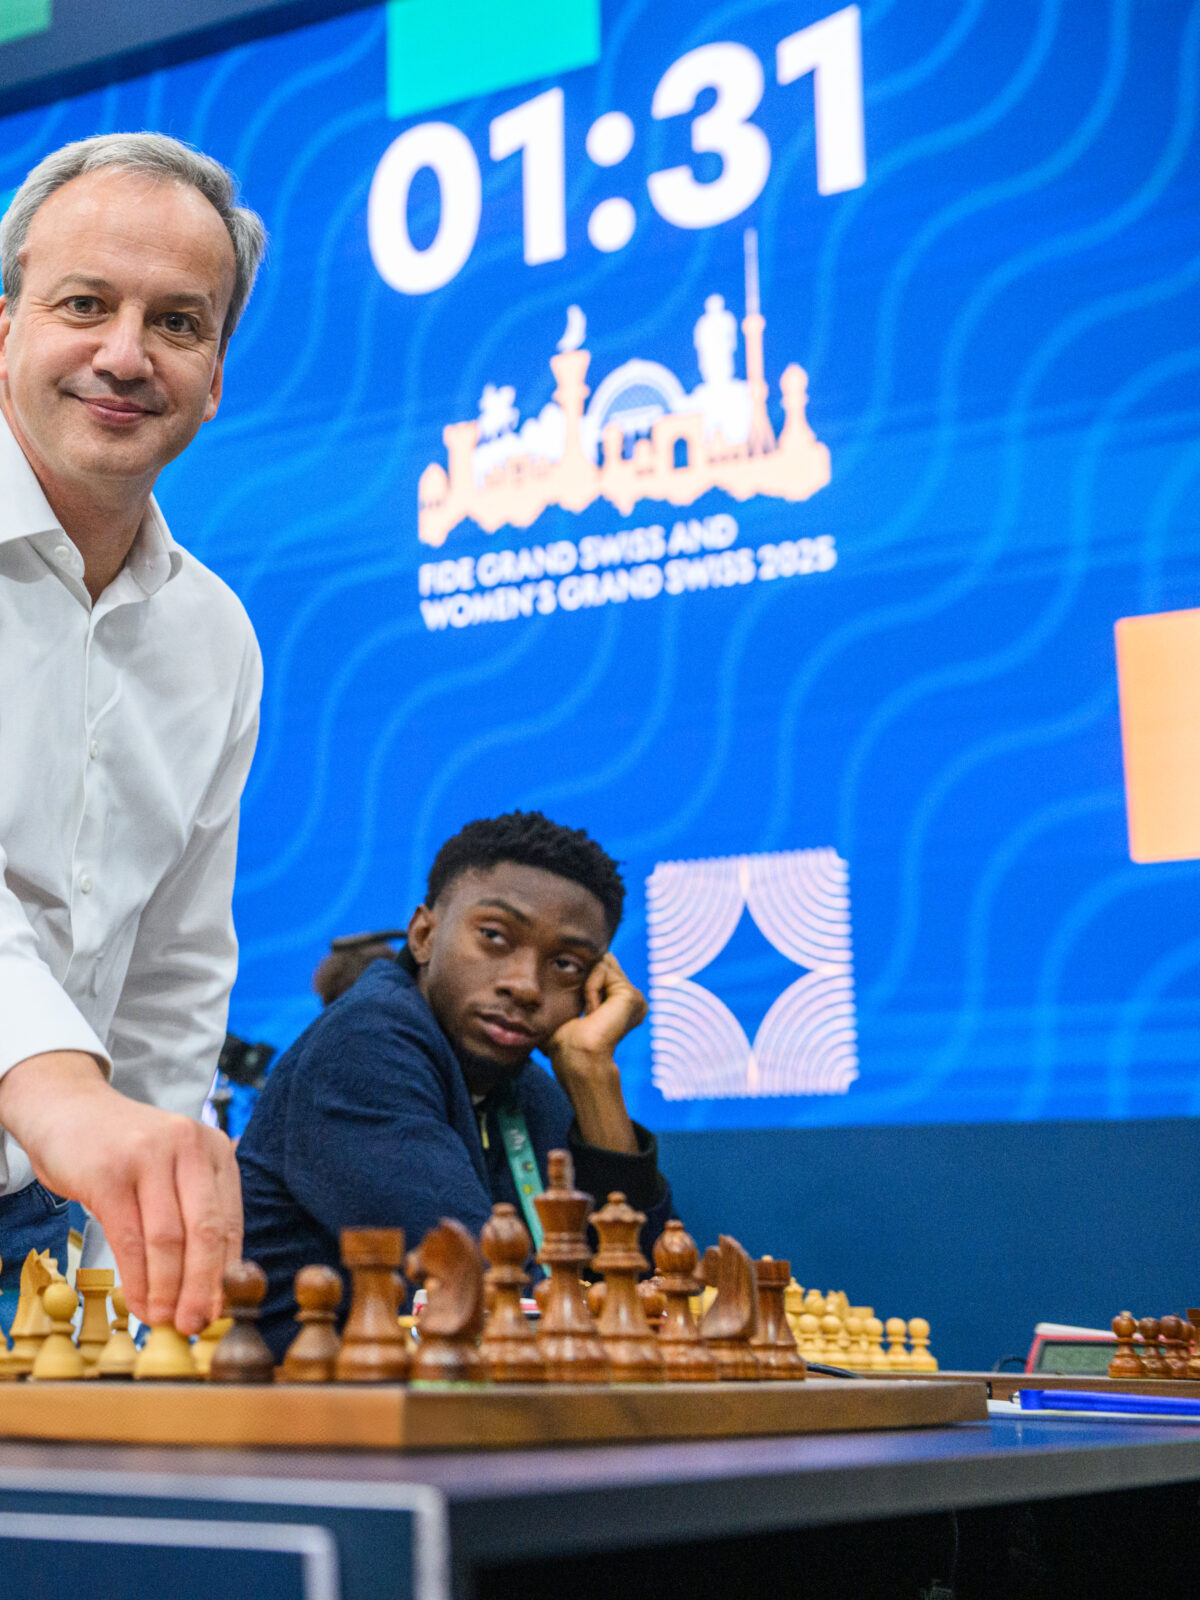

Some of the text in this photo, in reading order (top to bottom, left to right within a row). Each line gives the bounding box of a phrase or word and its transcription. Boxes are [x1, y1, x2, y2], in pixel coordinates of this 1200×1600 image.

[366, 3, 867, 296] 01:31
[418, 513, 739, 597] FIDE GRAND SWISS AND
[419, 534, 838, 632] WOMEN'S GRAND SWISS 2025
